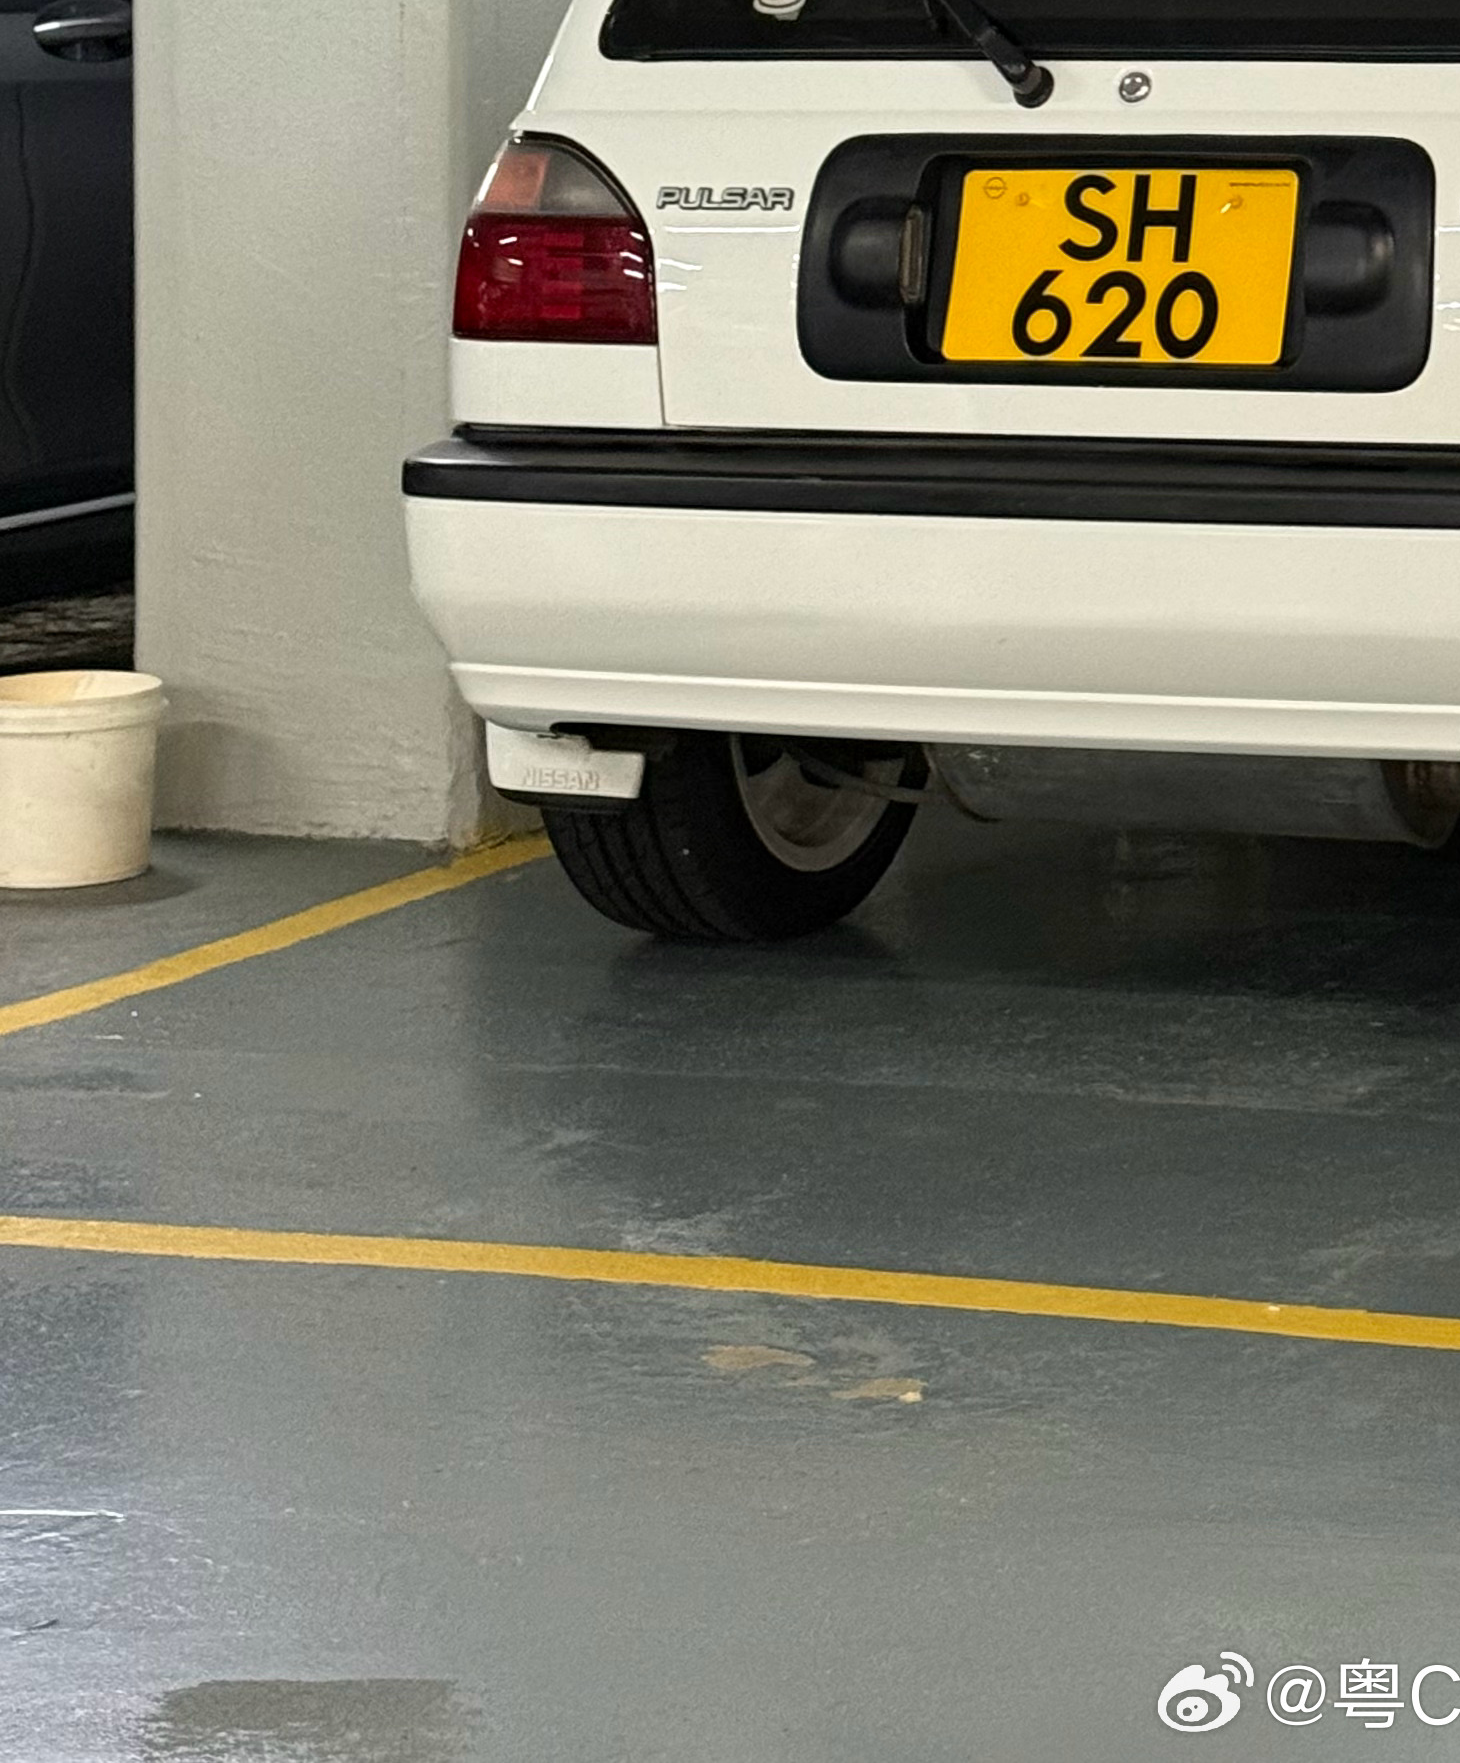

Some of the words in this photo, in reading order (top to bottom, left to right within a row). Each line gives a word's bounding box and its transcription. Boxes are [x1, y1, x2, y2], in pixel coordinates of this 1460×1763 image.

[656, 186, 795, 211] PULSAR
[1058, 173, 1198, 263] SH
[1011, 268, 1220, 360] 620
[522, 766, 601, 790] NISSAN
